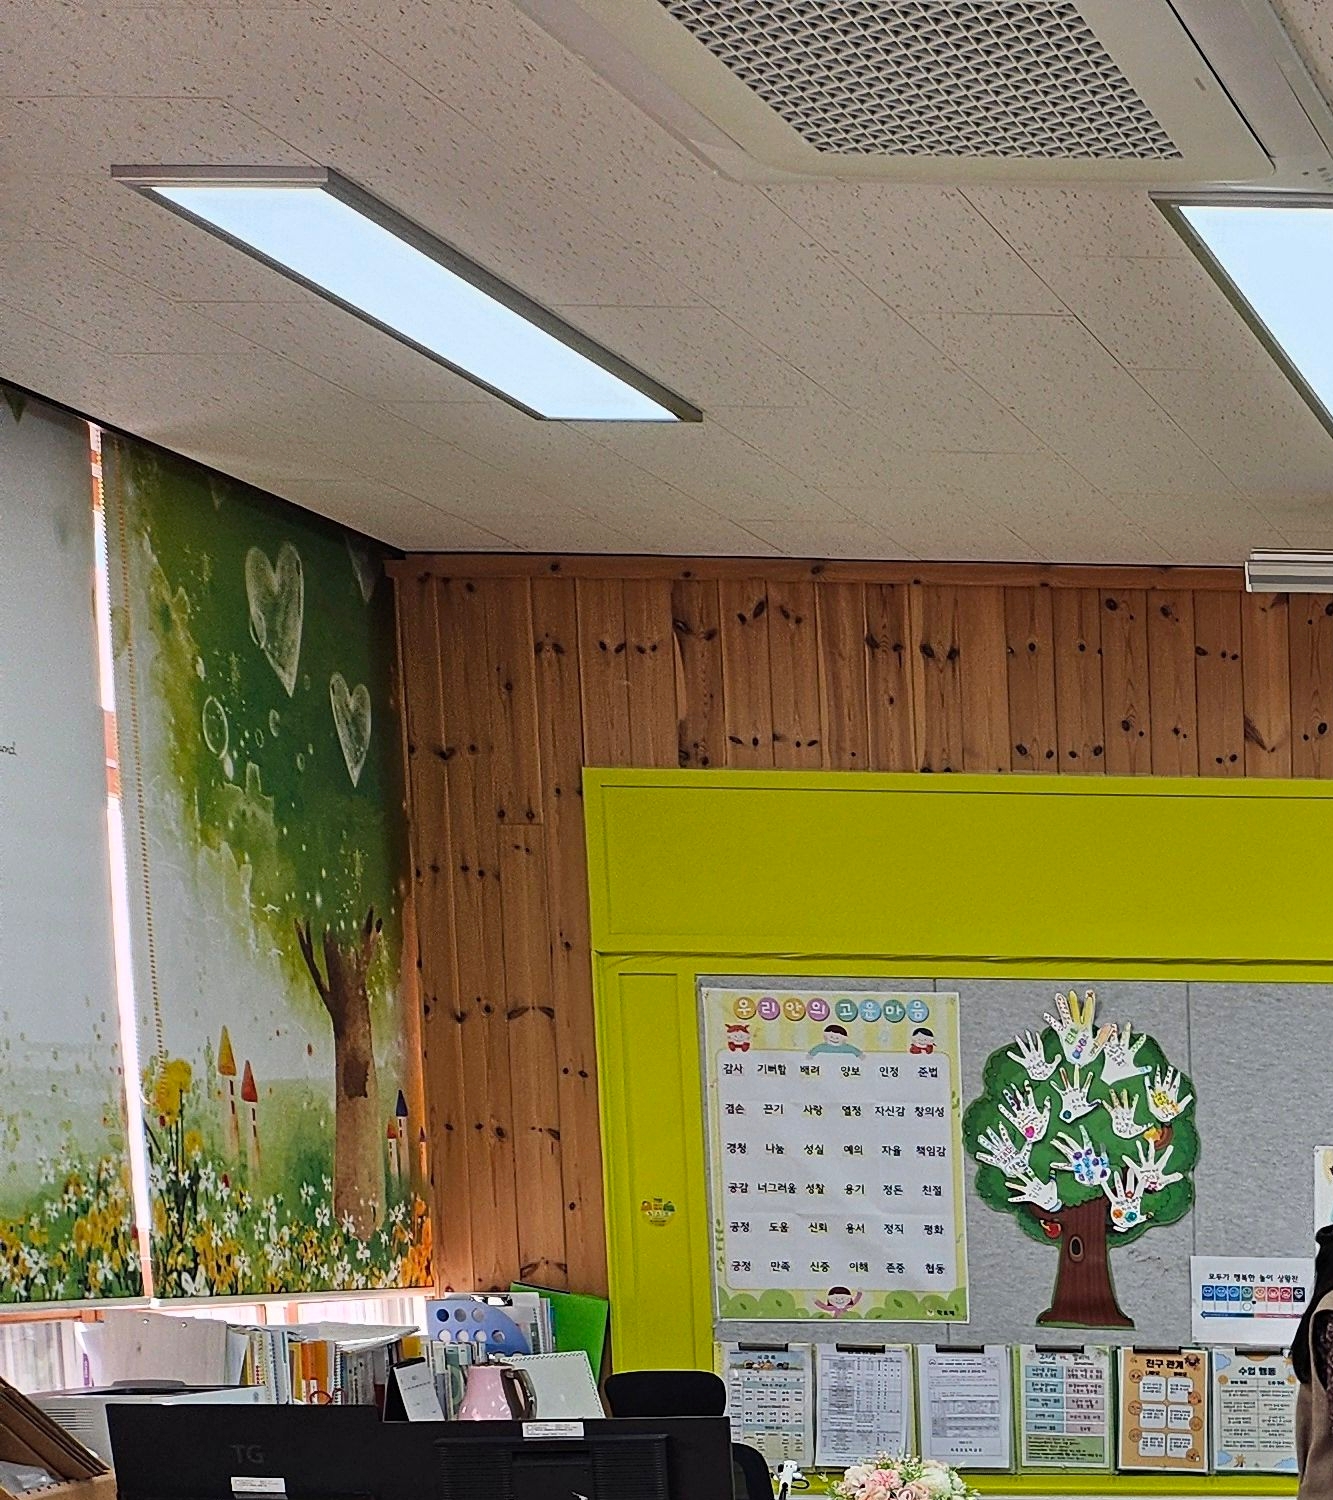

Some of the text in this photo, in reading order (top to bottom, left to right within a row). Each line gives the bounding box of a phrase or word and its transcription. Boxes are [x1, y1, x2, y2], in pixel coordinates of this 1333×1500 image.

[723, 1063, 743, 1075] 감사
[800, 1065, 820, 1076] 배려
[840, 1065, 861, 1078] 양보
[879, 1066, 899, 1078] 인정
[725, 1103, 745, 1114] 겸손
[803, 1104, 823, 1116] 사랑
[841, 1105, 862, 1117] 열정
[875, 1106, 905, 1117] 자신감
[914, 1106, 945, 1118] 창의성
[726, 1142, 747, 1154] 경청
[765, 1143, 785, 1155] 나눔
[804, 1143, 824, 1155] 성실
[843, 1144, 863, 1156] 예의
[881, 1145, 902, 1157] 자율
[916, 1145, 946, 1157] 책임감
[728, 1182, 749, 1194] 공감
[757, 1182, 797, 1194] 너그러움
[806, 1183, 825, 1194] 성찰
[844, 1183, 865, 1195] 용기
[883, 1184, 904, 1196] 정돈
[922, 1184, 942, 1196] 친절
[768, 1222, 790, 1233] 도움
[808, 1222, 828, 1233] 신뢰
[846, 1223, 865, 1234] 용서
[883, 1223, 904, 1235] 정직
[924, 1224, 945, 1235] 평화
[770, 1261, 791, 1272] 만족
[810, 1261, 831, 1273] 신중
[849, 1262, 869, 1272] 이해
[885, 1262, 906, 1274] 존중
[925, 1263, 945, 1275] 협동
[1146, 1359, 1184, 1370] 친구 관계
[1239, 1367, 1255, 1376] 수업
